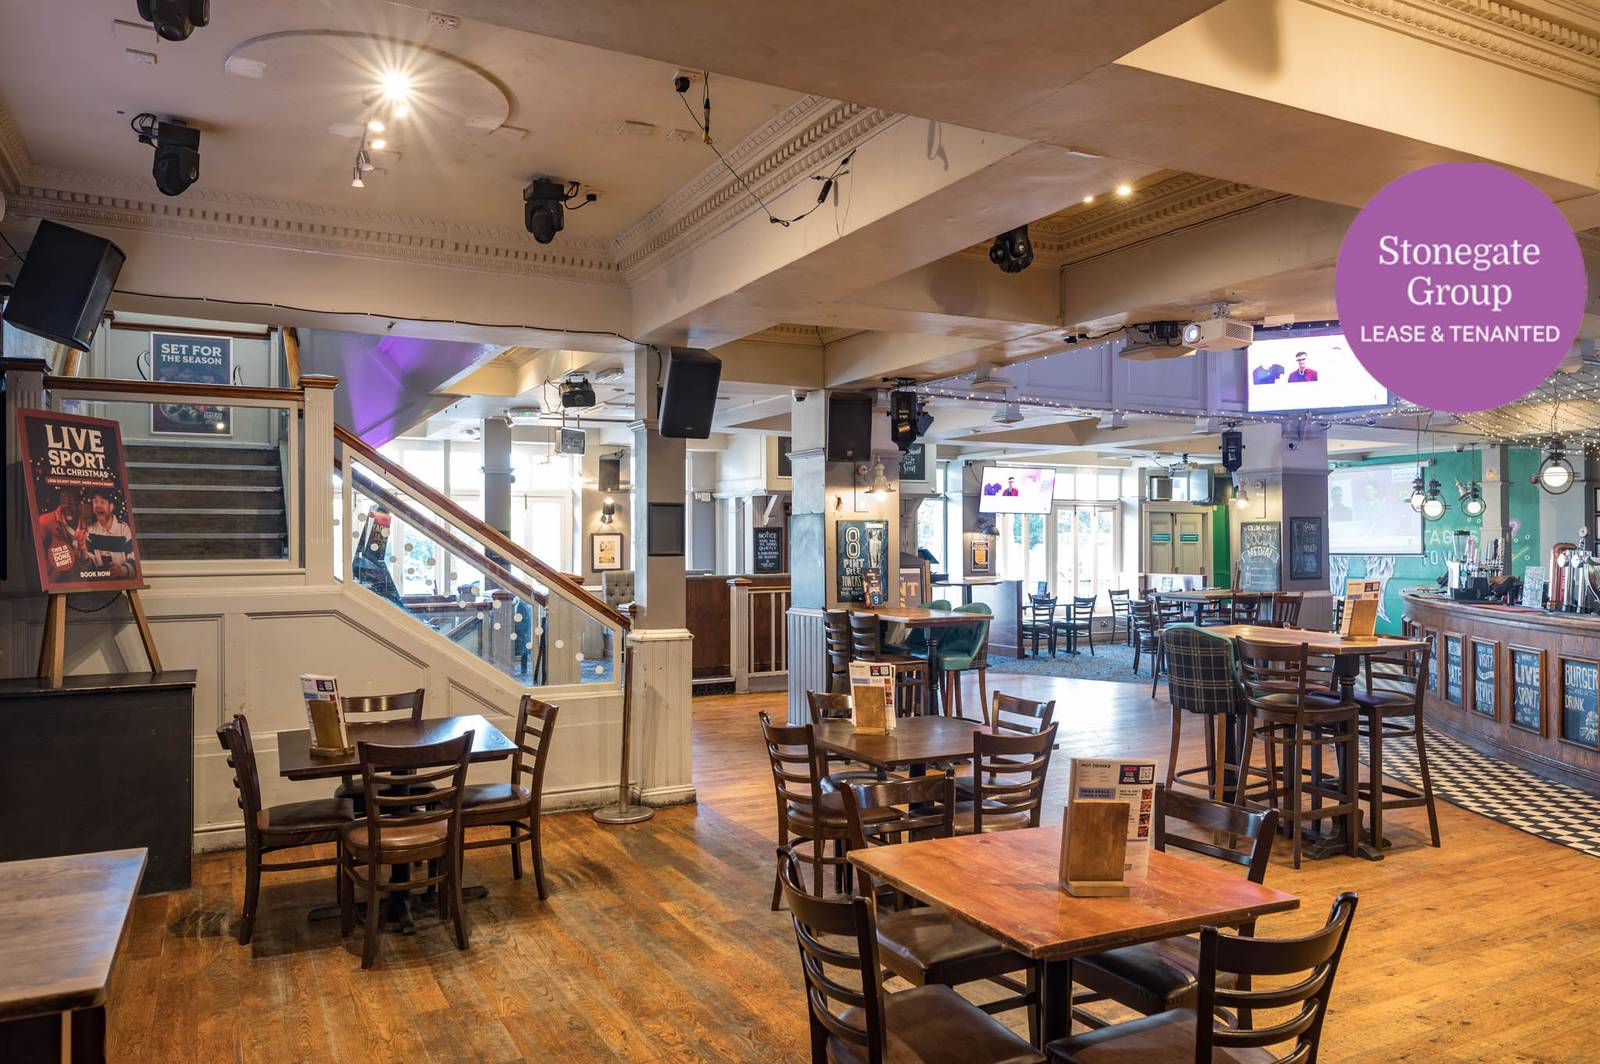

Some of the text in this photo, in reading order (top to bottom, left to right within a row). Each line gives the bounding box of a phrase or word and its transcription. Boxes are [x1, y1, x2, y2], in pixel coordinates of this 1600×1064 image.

[161, 343, 221, 357] SET FOR
[161, 354, 222, 365] THE SEASON
[45, 424, 104, 453] LIVE
[48, 449, 106, 470] SPORT
[51, 466, 109, 478] ALL CHRISTMAS
[845, 526, 861, 559] 8
[843, 559, 865, 569] PINT
[97, 570, 111, 578] NOW
[1514, 663, 1540, 686] LIVE
[1565, 664, 1599, 691] BURGER
[1517, 686, 1538, 709] SPORT
[1565, 695, 1585, 712] DRINK
